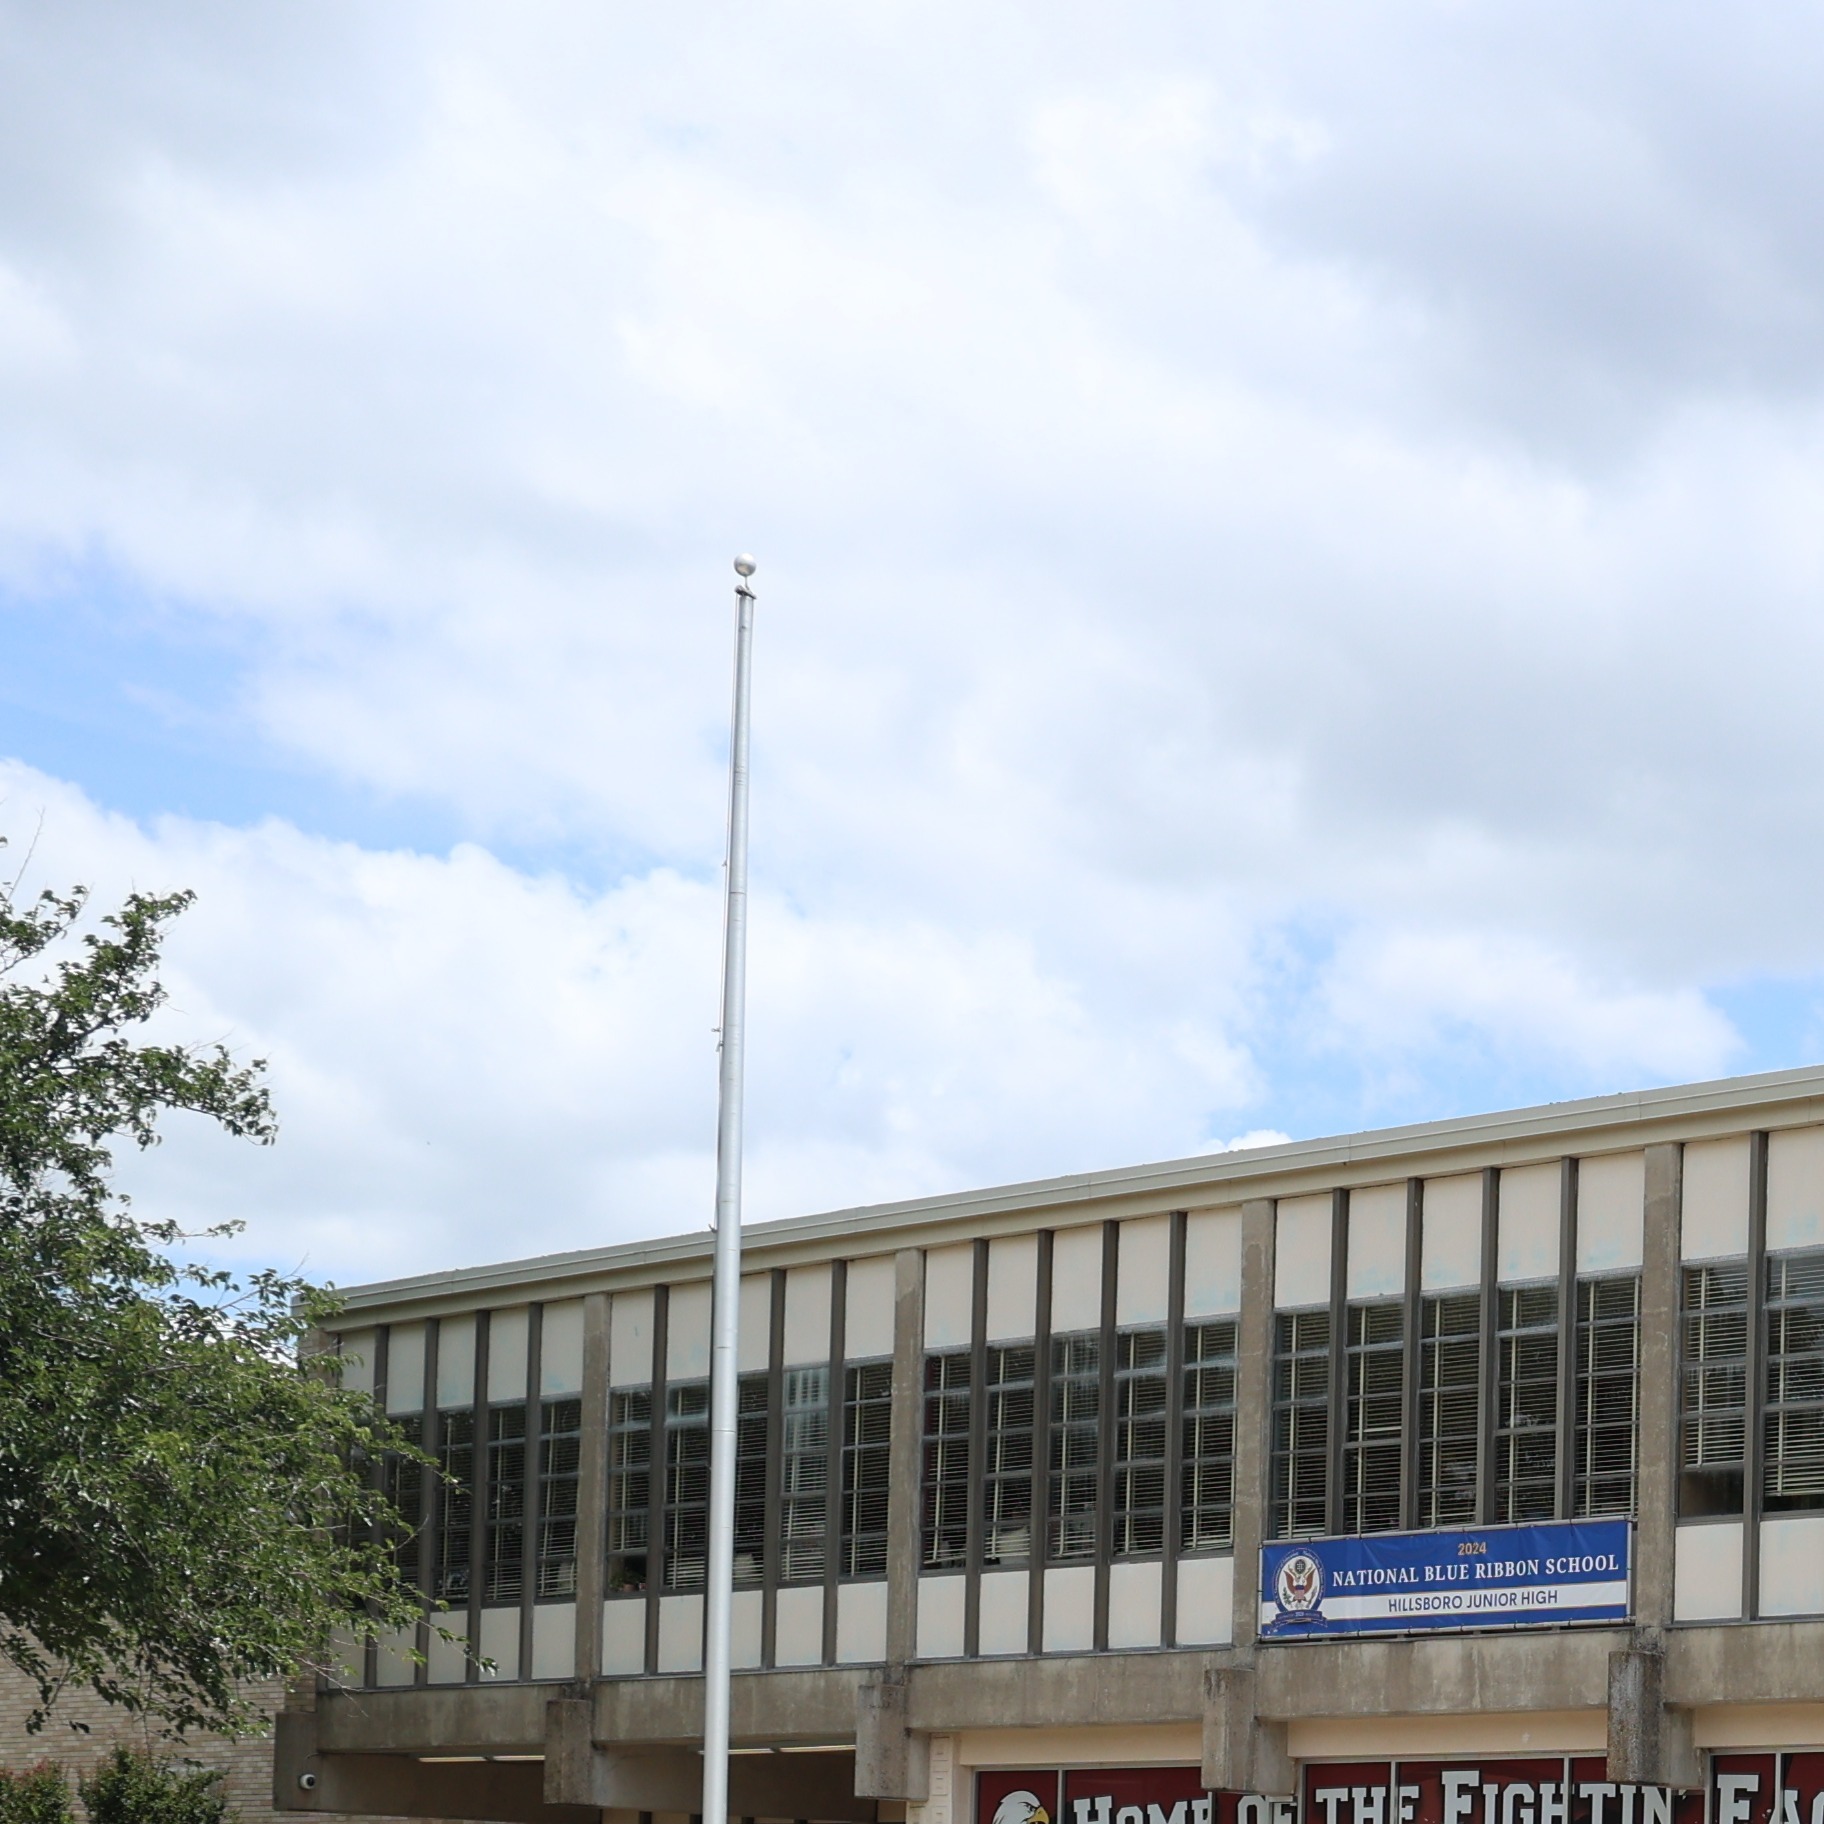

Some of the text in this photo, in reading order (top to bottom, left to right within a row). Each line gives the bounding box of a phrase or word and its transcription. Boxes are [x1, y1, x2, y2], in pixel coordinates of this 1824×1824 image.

[1457, 1542, 1487, 1556] 2024
[1332, 1554, 1619, 1587] NATIONAL BLUE RIBBON SCHOOL
[1388, 1590, 1559, 1613] HILLSBORO JUNIOR HIGH
